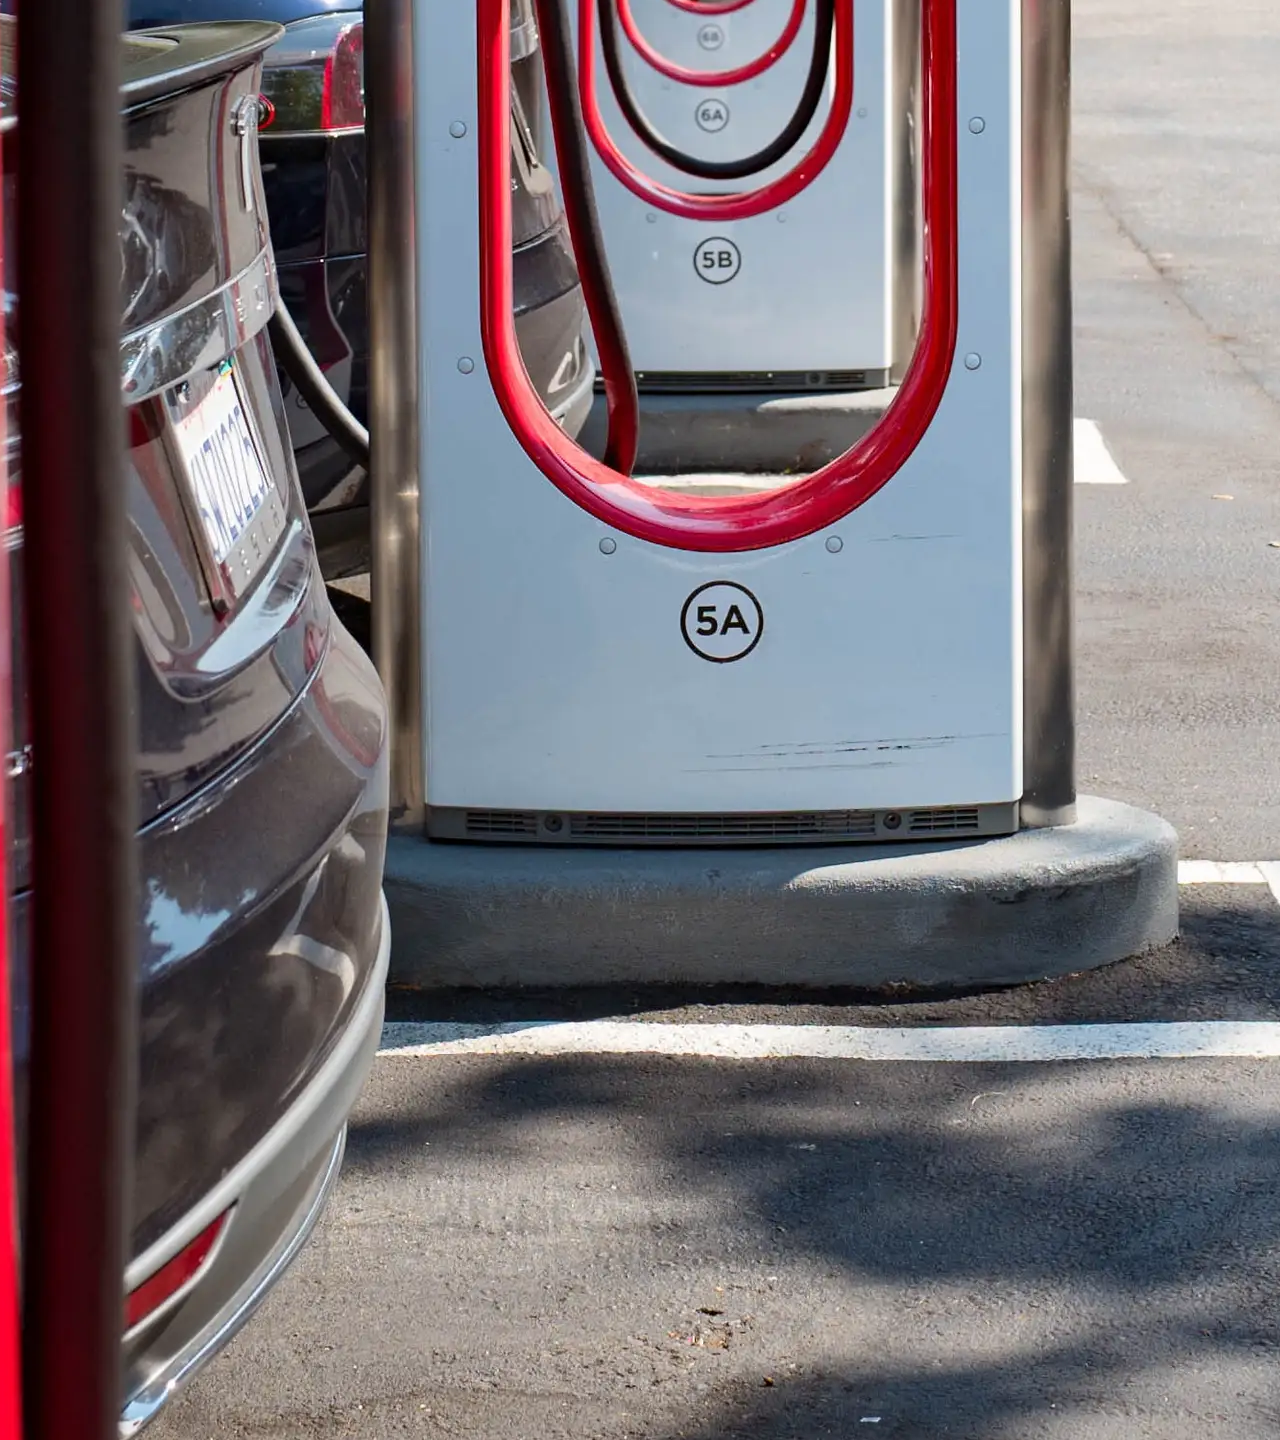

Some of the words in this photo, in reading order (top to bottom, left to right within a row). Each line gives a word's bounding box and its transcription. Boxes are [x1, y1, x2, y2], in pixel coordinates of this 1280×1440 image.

[701, 108, 724, 123] 6A
[702, 250, 733, 269] 5B
[696, 604, 751, 637] 5A
